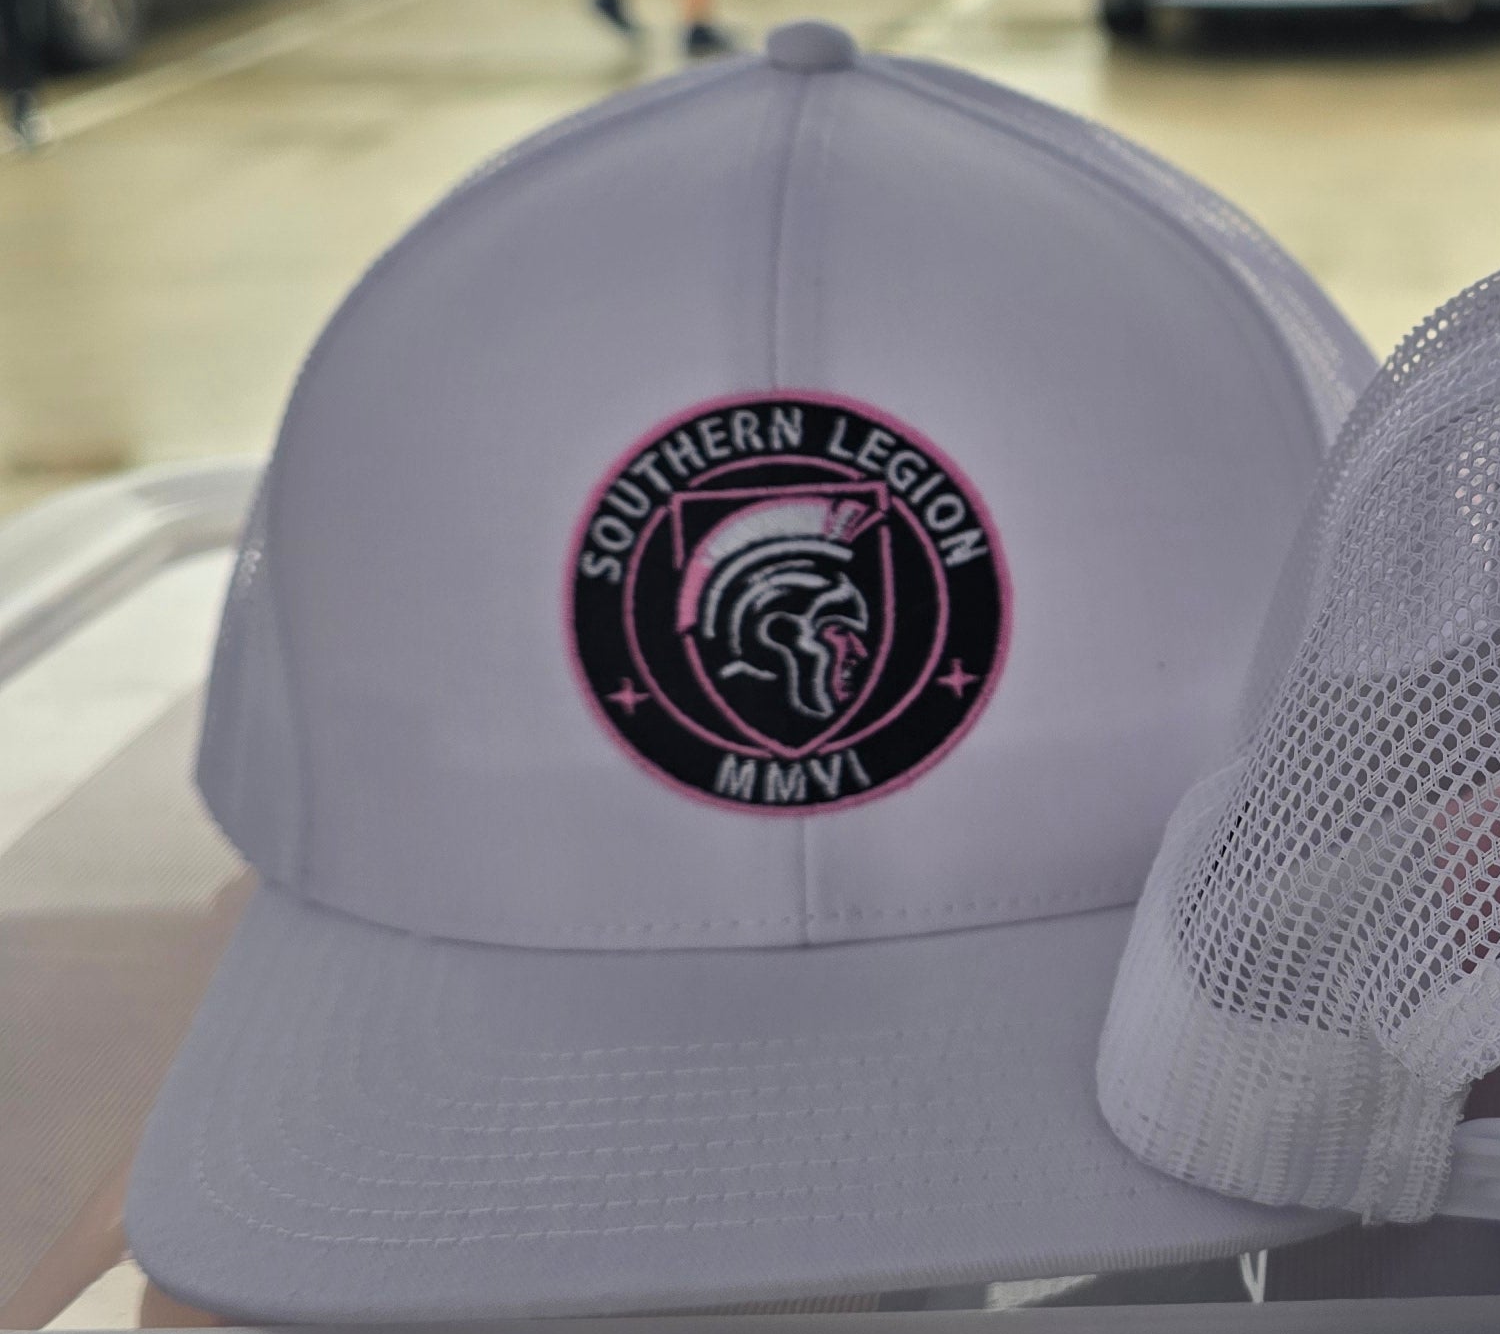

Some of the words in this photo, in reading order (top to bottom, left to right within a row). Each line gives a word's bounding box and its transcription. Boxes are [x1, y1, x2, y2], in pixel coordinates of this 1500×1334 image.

[580, 407, 802, 584] SOUTHERN
[826, 417, 988, 568] LEGION
[714, 749, 872, 803] MMVI
